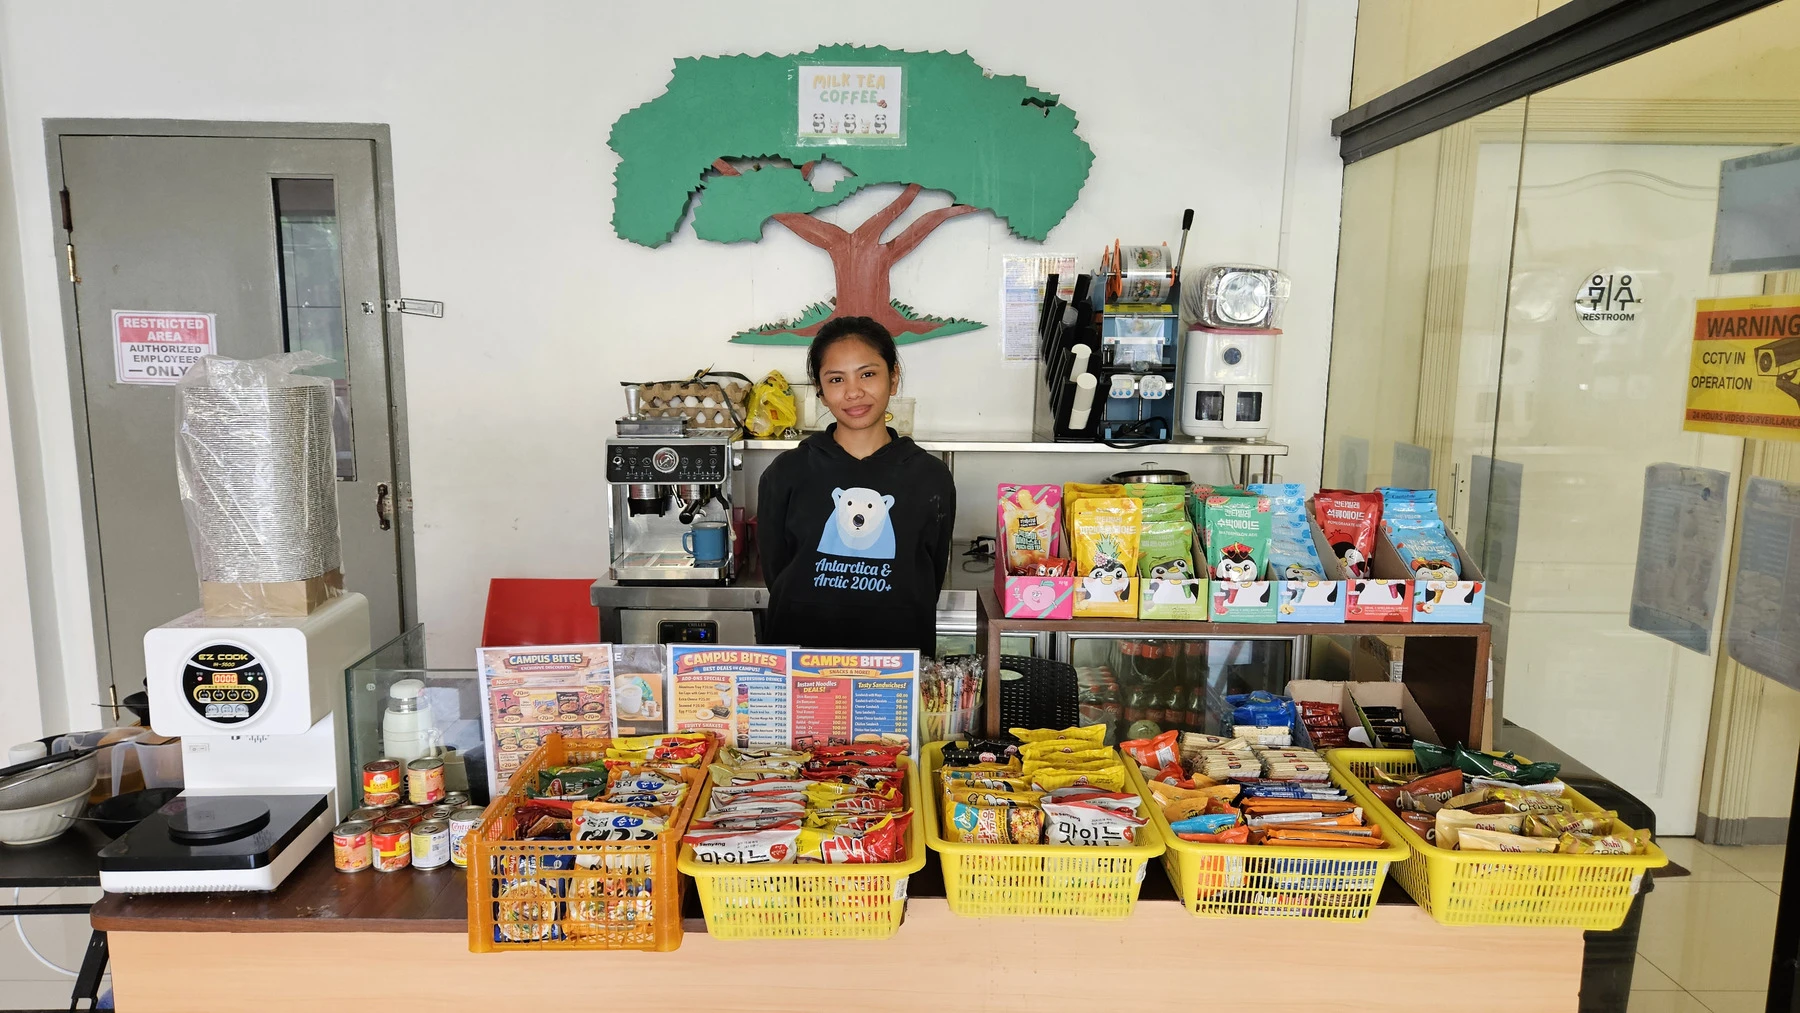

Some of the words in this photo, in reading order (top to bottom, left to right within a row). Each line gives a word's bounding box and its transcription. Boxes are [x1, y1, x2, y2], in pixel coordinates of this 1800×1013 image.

[813, 73, 850, 89] MILK
[857, 74, 885, 89] TEA
[820, 90, 878, 104] COFFEE
[123, 318, 204, 329] RESTRICTED
[1707, 313, 1800, 338] WARNING
[147, 332, 182, 341] AREA
[130, 344, 202, 353] AUTHORIZED
[134, 354, 199, 363] EMPLOYEES
[1702, 352, 1732, 365] CCTV
[1734, 352, 1746, 365] IN
[146, 366, 188, 377] ONLY
[1692, 376, 1753, 390] OPERATION
[1692, 411, 1700, 419] 24
[1701, 412, 1723, 421] HOURS
[1725, 413, 1746, 423] VIDEO
[1747, 415, 1800, 427] SURVEILLANCE
[816, 558, 878, 576] Antarctica
[881, 564, 892, 577] &
[814, 574, 849, 589] Arctic
[850, 576, 892, 592] 2000+
[510, 654, 552, 665] CAMPUS
[553, 654, 582, 663] BITES
[684, 652, 738, 666] CAMPUS
[740, 652, 778, 667] BITES
[801, 655, 858, 667] CAMPUS
[861, 656, 901, 668] BITES
[1476, 823, 1496, 832] Oishi
[1499, 844, 1522, 853] Oishi
[1601, 839, 1622, 848] Oishi
